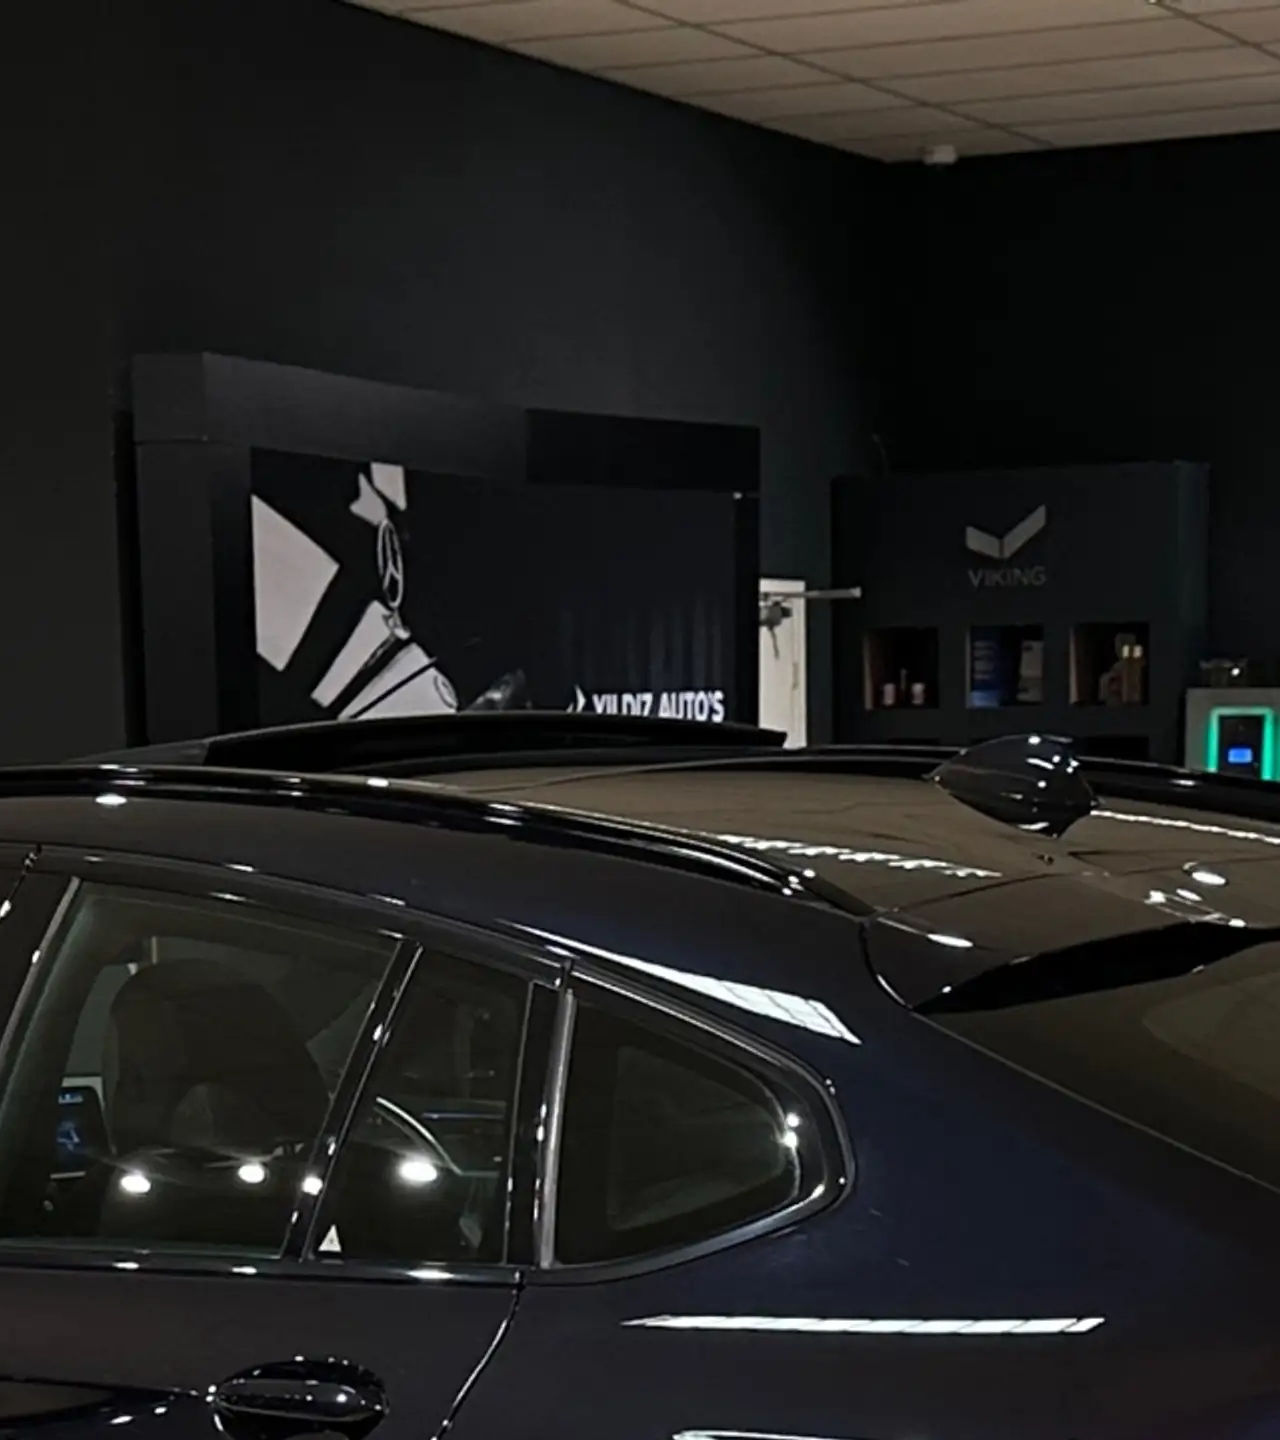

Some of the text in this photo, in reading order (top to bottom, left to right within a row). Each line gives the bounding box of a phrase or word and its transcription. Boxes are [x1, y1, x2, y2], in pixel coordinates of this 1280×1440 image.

[967, 565, 1047, 589] VIKING
[592, 690, 725, 723] YILDIZ AUTO'S
